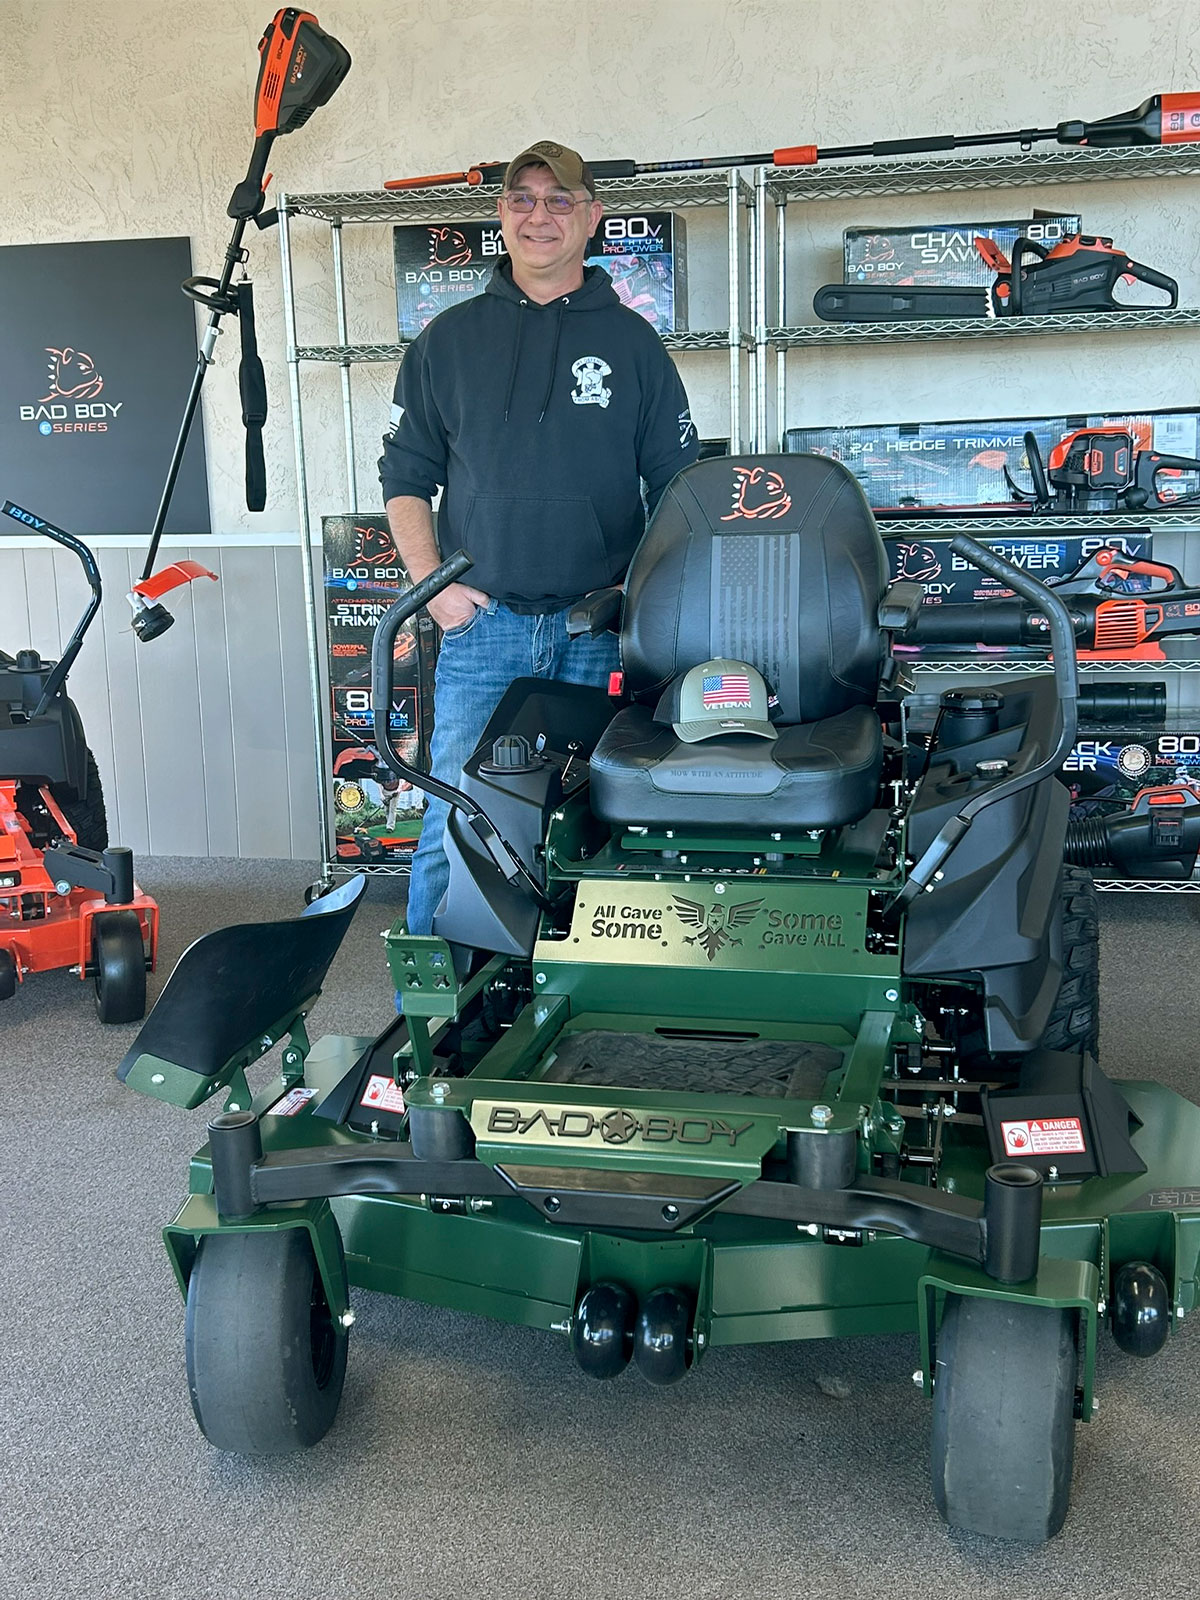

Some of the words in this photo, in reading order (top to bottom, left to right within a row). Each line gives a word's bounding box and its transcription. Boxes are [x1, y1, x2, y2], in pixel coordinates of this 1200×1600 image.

[602, 238, 664, 247] LITHIUM
[603, 244, 663, 254] PROPOWER
[848, 264, 874, 273] BAD
[878, 262, 904, 271] BOY
[405, 271, 442, 283] BAD
[449, 268, 487, 281] BOY
[1090, 273, 1105, 281] BOY
[19, 404, 67, 420] BAD
[75, 402, 123, 419] BOY
[886, 439, 946, 453] HEDGE
[952, 436, 1026, 449] TRIMME
[8, 505, 46, 530] BOY
[332, 567, 369, 579] BAD
[374, 567, 408, 579] BOY
[337, 603, 390, 615] STRIN
[703, 701, 752, 711] VETERAN
[670, 769, 688, 777] MOW
[691, 770, 711, 778] WITH
[713, 770, 723, 778] AN
[723, 770, 763, 778] ATTITUDE
[593, 904, 616, 919] All
[621, 906, 663, 921] Gave
[768, 909, 843, 930] Some
[590, 919, 663, 940] Some
[761, 931, 808, 946] Gave
[813, 932, 846, 948] ALL
[488, 1106, 595, 1137] BAD
[642, 1115, 754, 1146] BOY
[1043, 1121, 1079, 1131] DANGER
